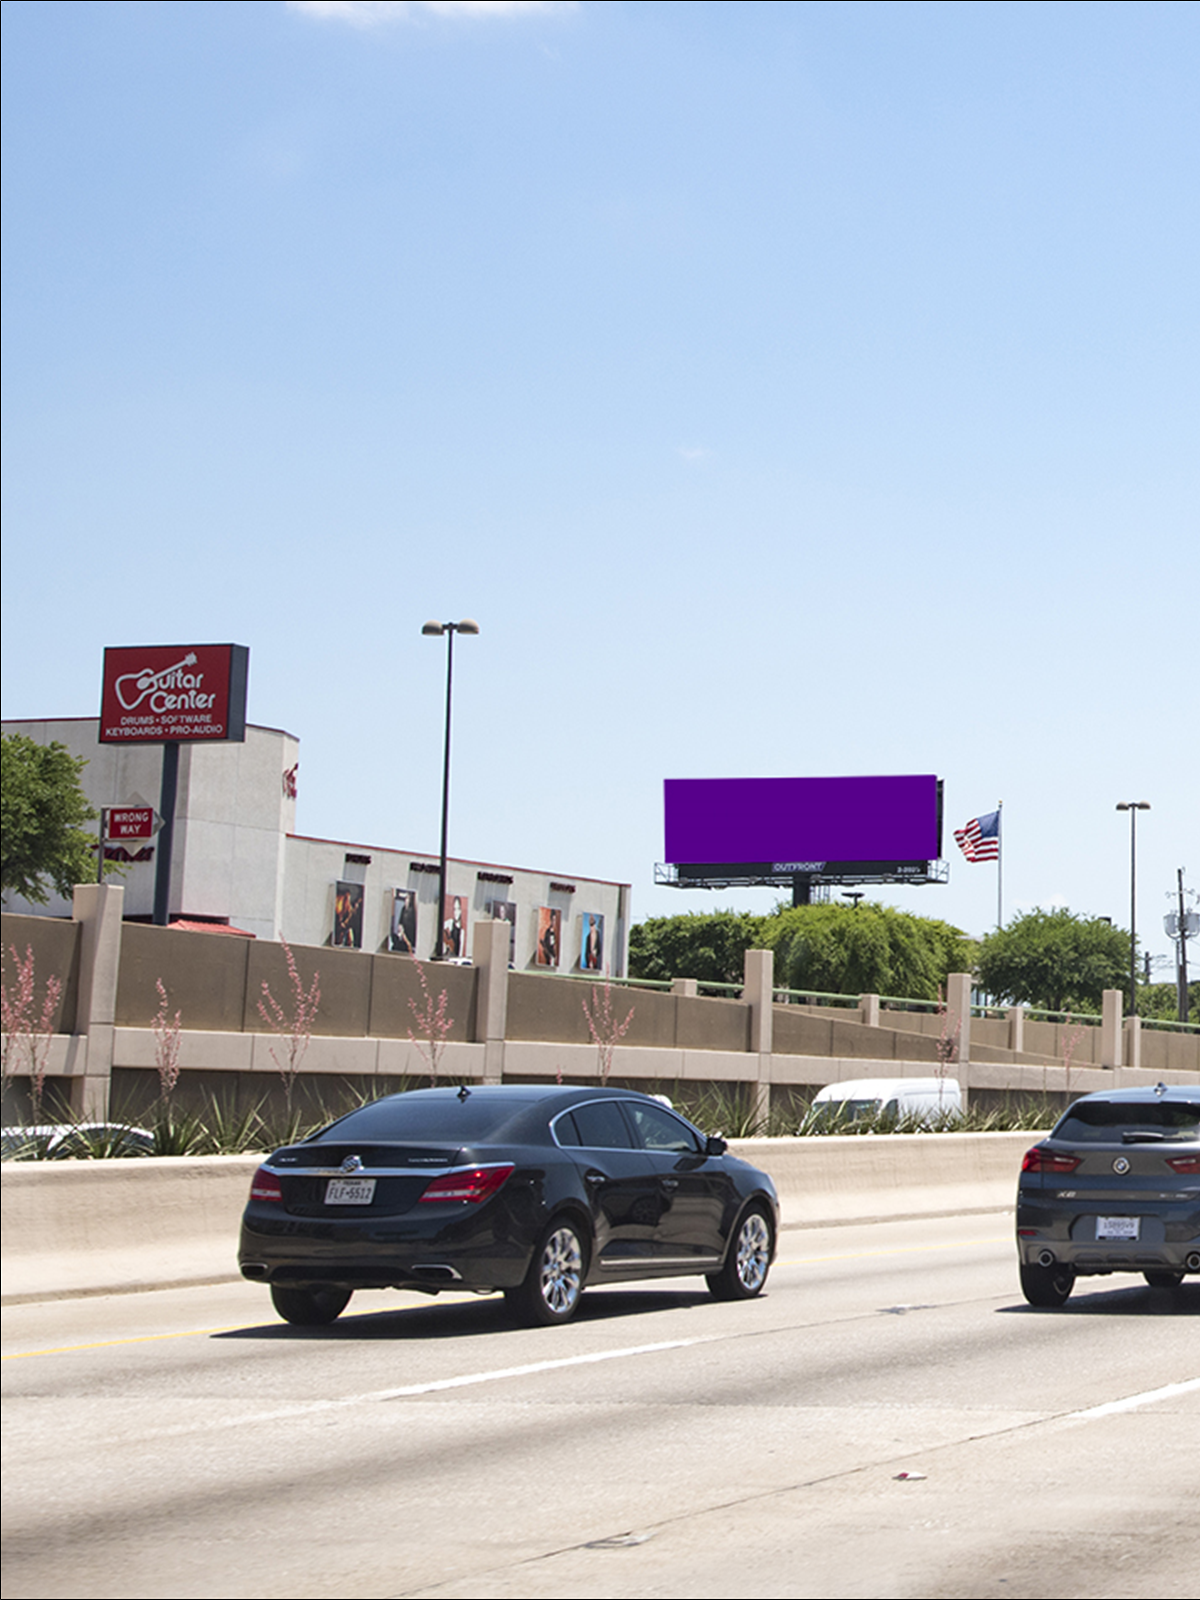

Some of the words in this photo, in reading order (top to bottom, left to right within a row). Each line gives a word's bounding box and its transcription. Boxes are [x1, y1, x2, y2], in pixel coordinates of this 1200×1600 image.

[150, 690, 216, 713] Center
[121, 715, 155, 726] DRUMS
[161, 714, 212, 725] SOFTWARE
[105, 726, 163, 737] KEYBOARDS
[170, 724, 223, 735] PRO-AUDIO
[113, 812, 149, 823] WRONG
[120, 824, 141, 835] WAY
